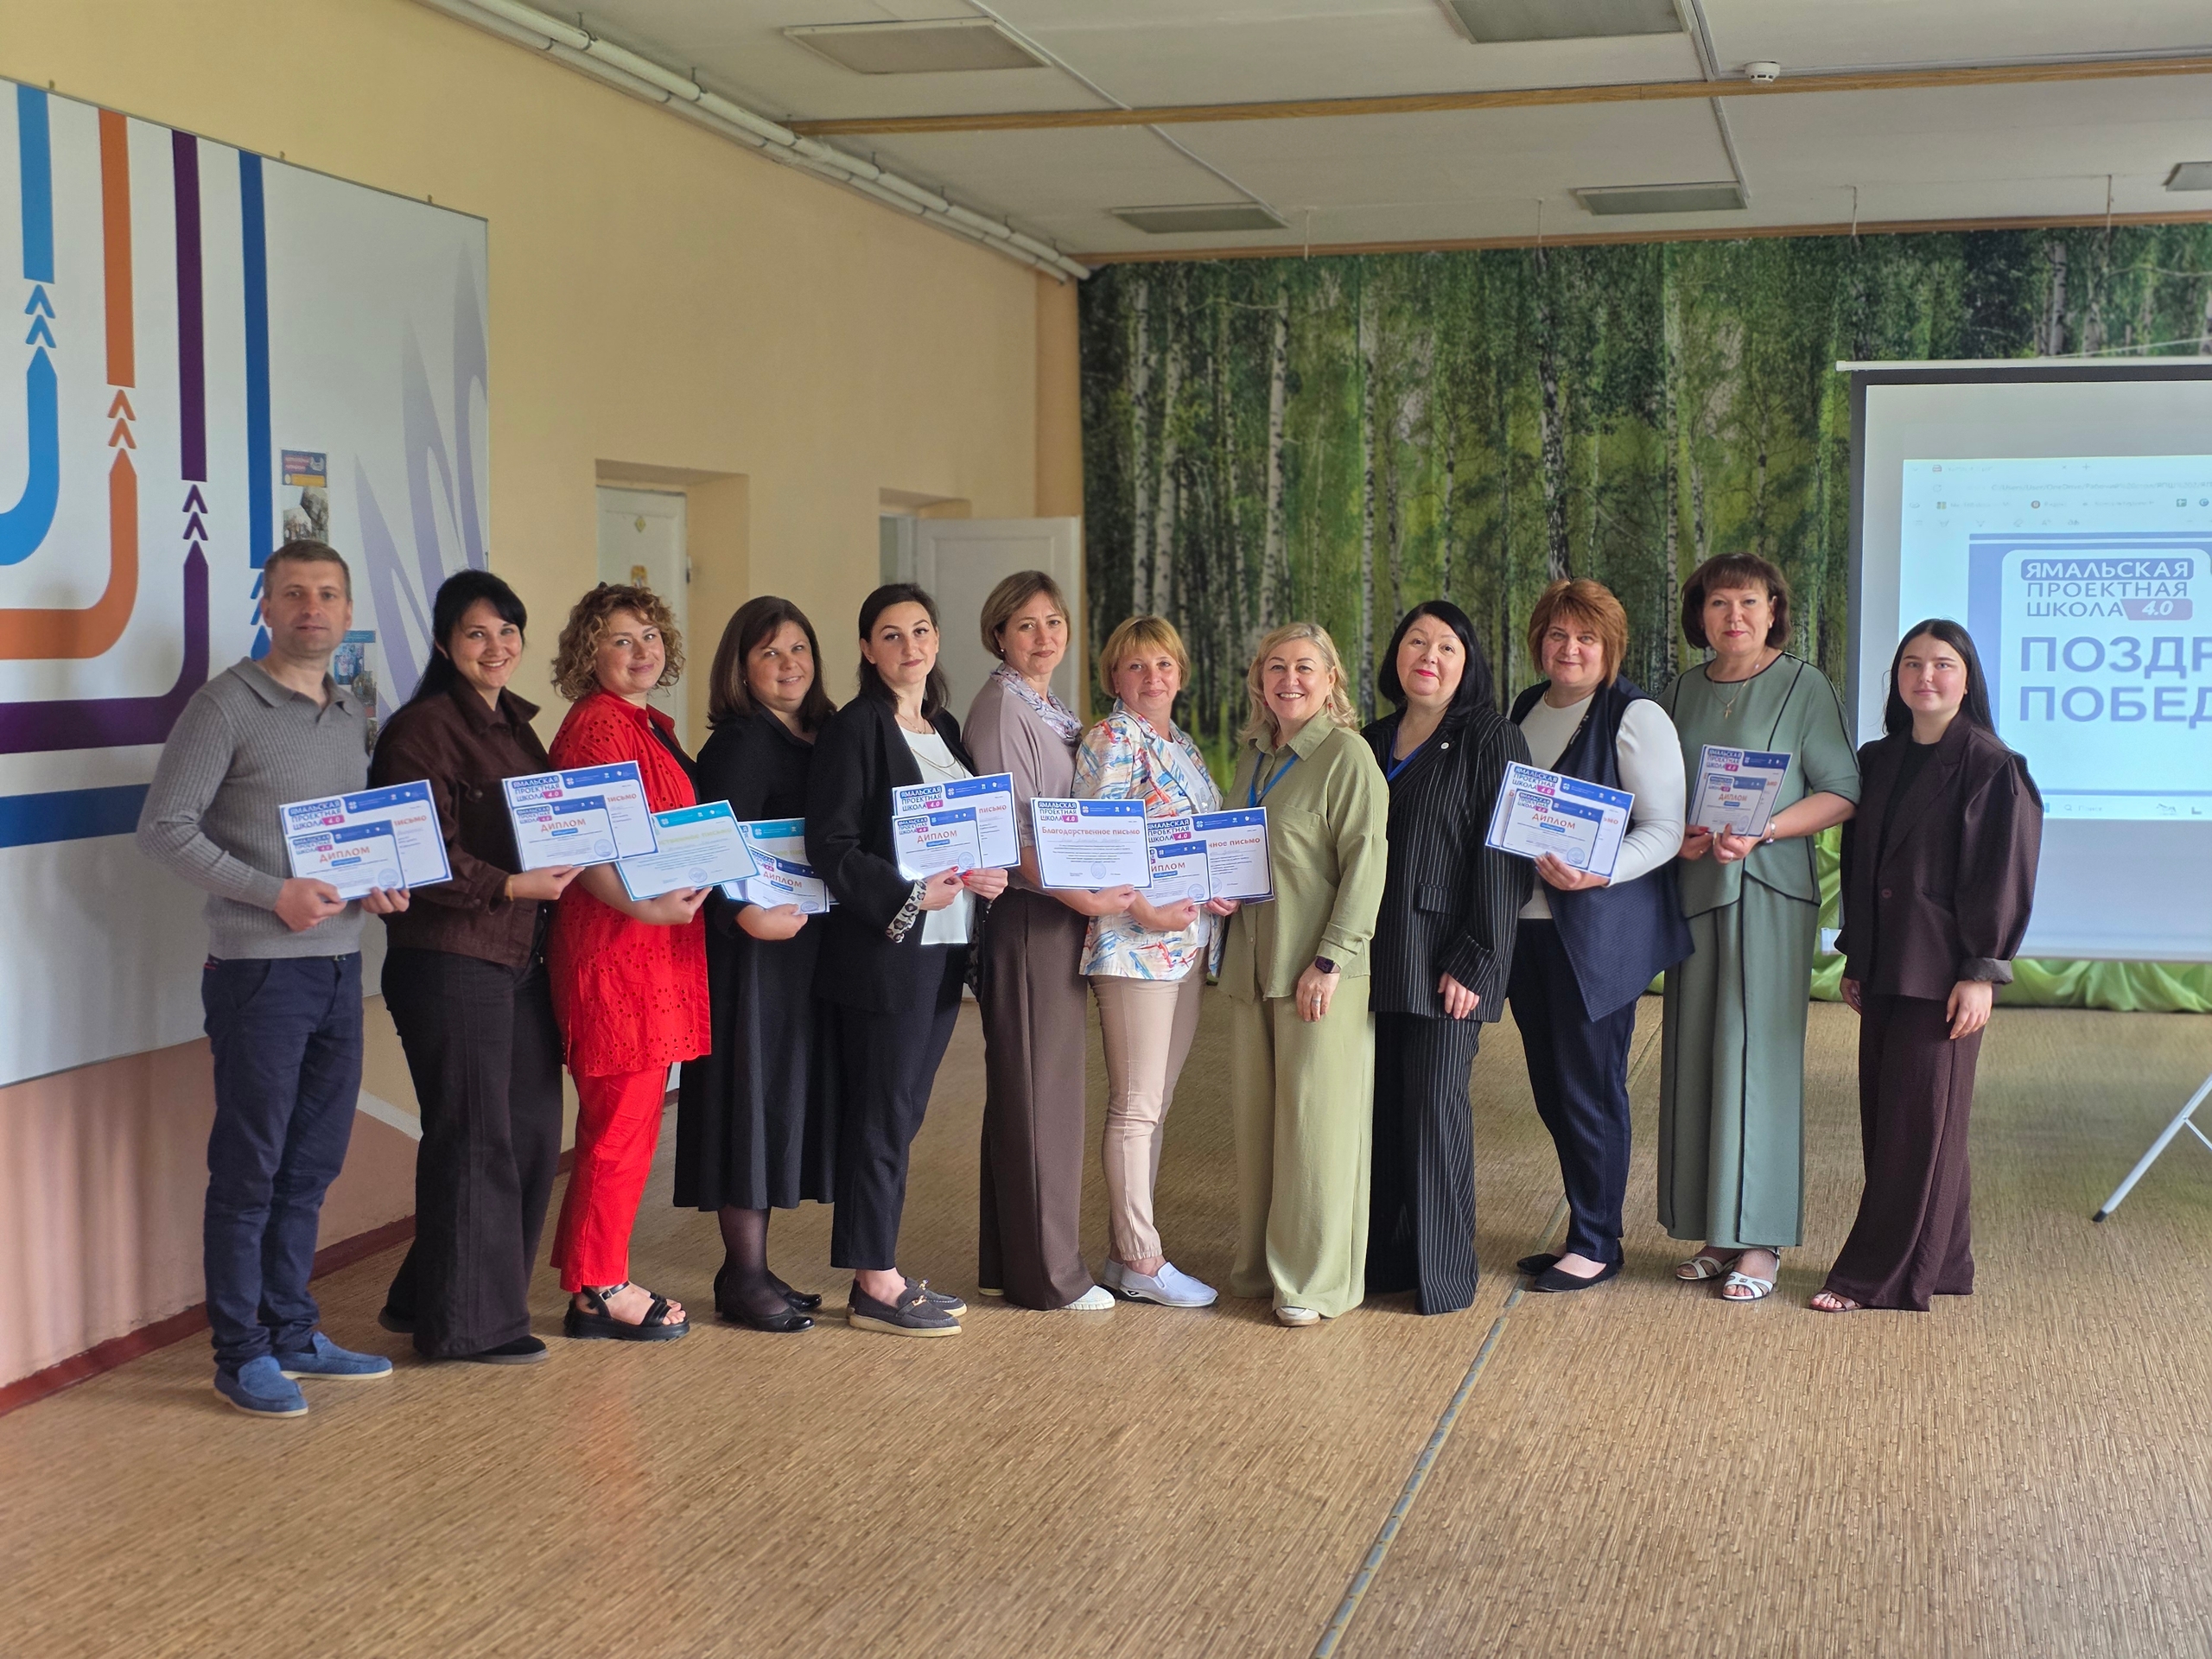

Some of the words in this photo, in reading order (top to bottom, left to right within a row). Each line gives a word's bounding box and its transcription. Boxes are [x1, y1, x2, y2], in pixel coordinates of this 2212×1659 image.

[2025, 561, 2189, 578] ЯМАЛЬСКАЯ
[2027, 582, 2188, 597] ПРОЕКТНАЯ
[2027, 601, 2122, 617] ШКОЛА
[2142, 601, 2174, 615] 4.0
[1516, 767, 1557, 782] ЯМАЛЬСКАЯ
[513, 777, 559, 788] ЯМАЛЬСКАЯ
[1512, 779, 1537, 790] ШКОЛА
[1514, 774, 1556, 788] ПРОЕКТНАЯ
[515, 784, 560, 795] ПРОЕКТНАЯ
[901, 787, 942, 798] ЯМАЛЬСКАЯ
[516, 793, 543, 802] ШКОЛА
[902, 795, 942, 804] ПРОЕКТНАЯ
[290, 800, 340, 815] ЯМАЛЬСКАЯ
[902, 803, 926, 811] ШКОЛА
[291, 809, 341, 823] ПРОЕКТНАЯ
[1532, 813, 1575, 830] ДИПЛОМ
[293, 820, 324, 830] ШКОЛА
[541, 818, 586, 832] ДИПЛОМ
[1147, 819, 1189, 830] ЯМАЛЬСКАЯ
[917, 830, 957, 843] ДИПЛОМ
[1042, 827, 1110, 836] Благодарственное
[1147, 827, 1189, 836] ПРОЕКТНАЯ
[320, 846, 370, 863] ДИПЛОМ
[1151, 862, 1185, 872] ИПЛОМ
[763, 871, 802, 887] ДИПЛОМ
